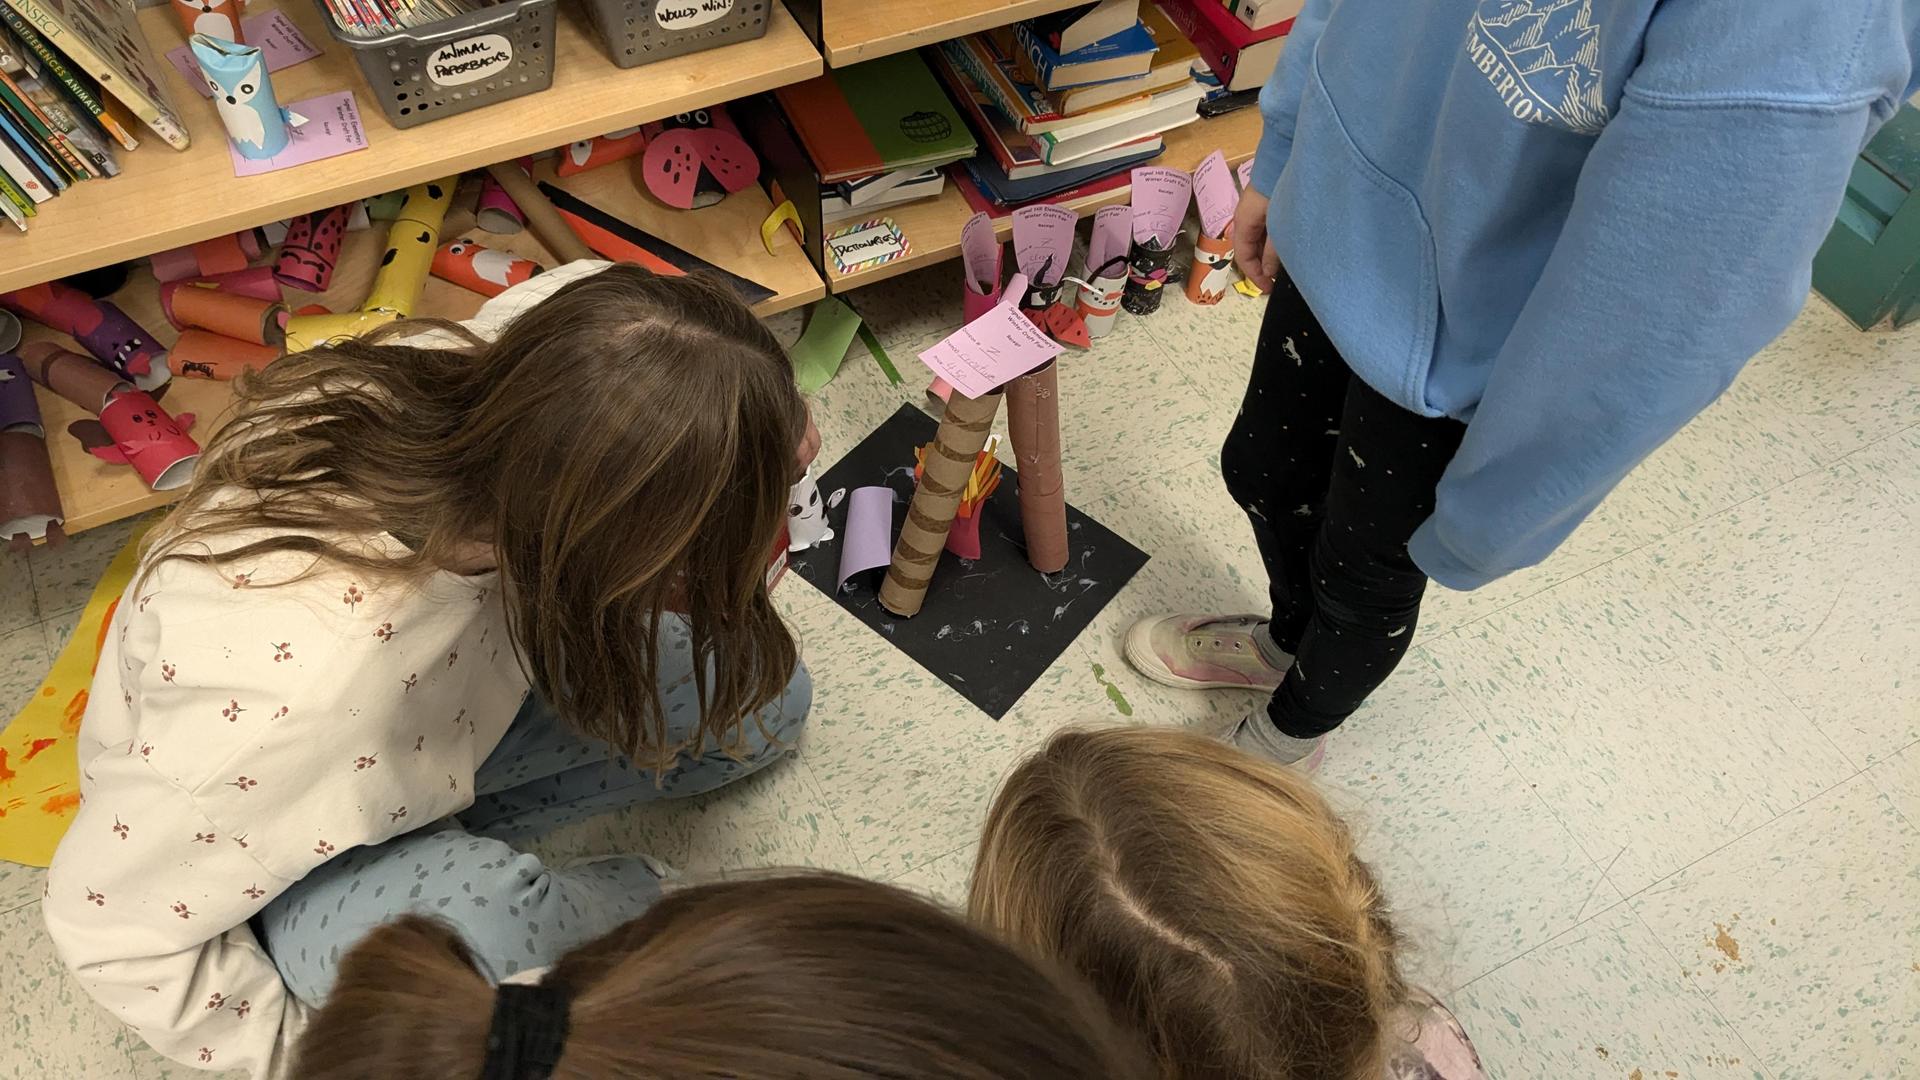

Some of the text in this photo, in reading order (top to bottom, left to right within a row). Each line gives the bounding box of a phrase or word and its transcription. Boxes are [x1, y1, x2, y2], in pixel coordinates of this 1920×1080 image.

[657, 7, 698, 22] WOULD
[434, 51, 510, 78] PAPERBACKS
[438, 42, 491, 62] ANIMAL
[13, 20, 66, 78] DIFFERENCES
[64, 78, 101, 116] ANIMALS
[1008, 306, 1024, 321] Signal
[1021, 319, 1031, 329] Hill
[1008, 315, 1023, 332] Winter
[1022, 331, 1036, 343] Craft
